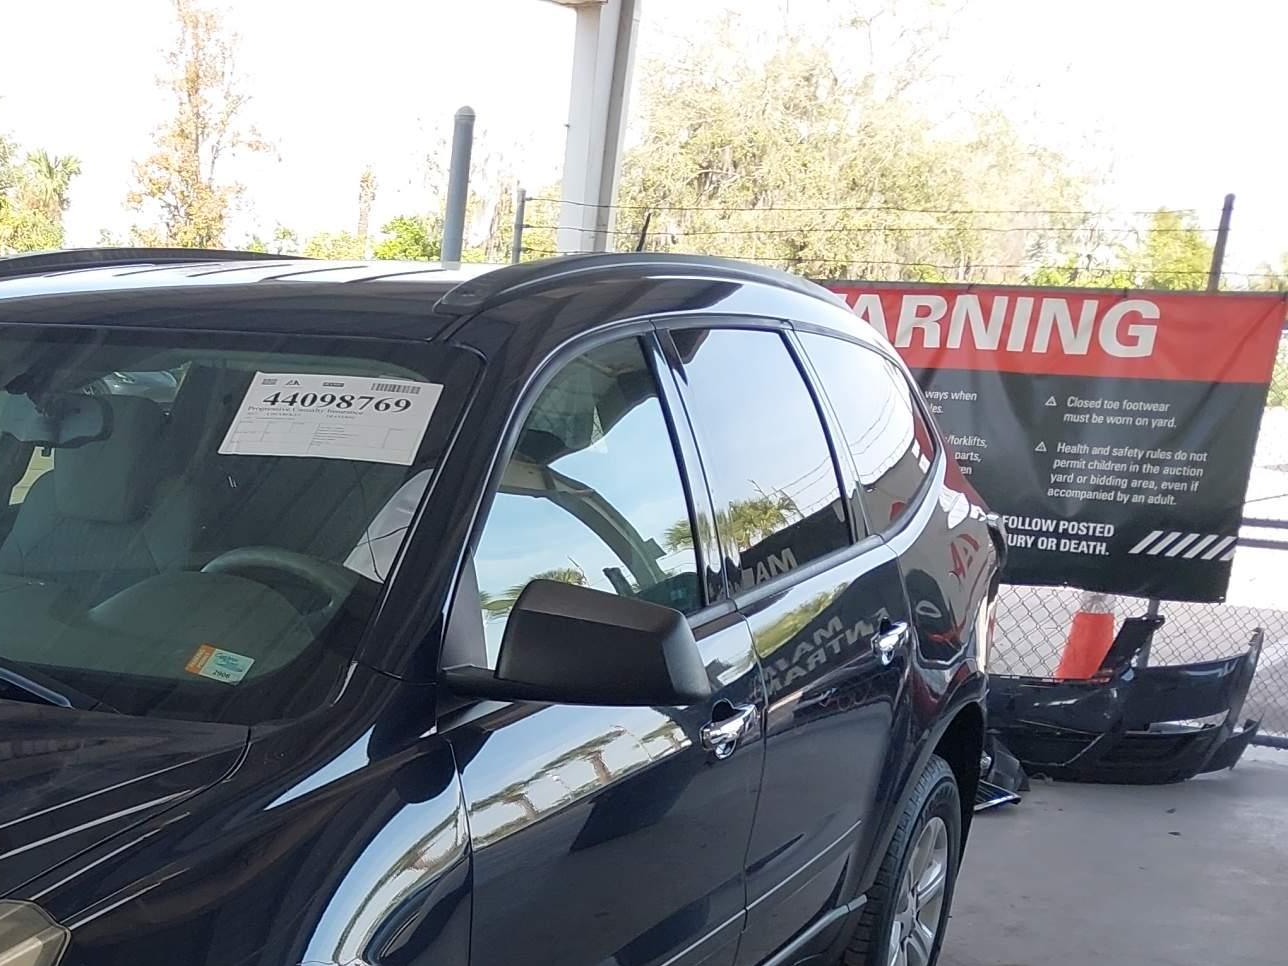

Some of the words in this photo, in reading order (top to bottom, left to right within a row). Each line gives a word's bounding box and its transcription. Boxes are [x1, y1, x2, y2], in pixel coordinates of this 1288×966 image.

[838, 293, 1161, 358] ARNING
[262, 391, 412, 413] 44098769
[951, 390, 978, 401] when
[1067, 396, 1102, 409] Closed
[1103, 399, 1120, 410] toe
[1122, 400, 1170, 412] footwear
[931, 404, 944, 414] es.
[1063, 413, 1089, 423] must
[1092, 414, 1104, 424] be
[1106, 416, 1133, 426] worn
[1135, 418, 1148, 426] on
[1151, 416, 1177, 428] yard.
[945, 434, 988, 449] /forklifts,
[1057, 442, 1090, 455] Health
[1091, 445, 1110, 456] and
[1112, 446, 1143, 460] safety
[1145, 449, 1172, 460] rules
[1174, 450, 1187, 461] do
[1189, 452, 1209, 462] not
[1053, 458, 1086, 470] permit
[1088, 461, 1127, 473] children
[1129, 462, 1139, 473] in
[1142, 464, 1160, 474] the
[1163, 466, 1204, 477] auction
[1050, 472, 1074, 484] yard
[1076, 475, 1088, 484] or
[1090, 474, 1128, 489] bidding
[1131, 479, 1158, 490] area,
[1161, 481, 1187, 491] even
[1191, 481, 1200, 492] if
[1047, 488, 1114, 501] accompanied
[1117, 491, 1129, 504] by
[1132, 494, 1145, 503] an
[1148, 494, 1177, 506] adult.
[1002, 515, 1056, 532] FOLLOW
[1058, 520, 1114, 537] POSTED
[1037, 537, 1057, 551] OR
[1059, 539, 1110, 556] DEATH.
